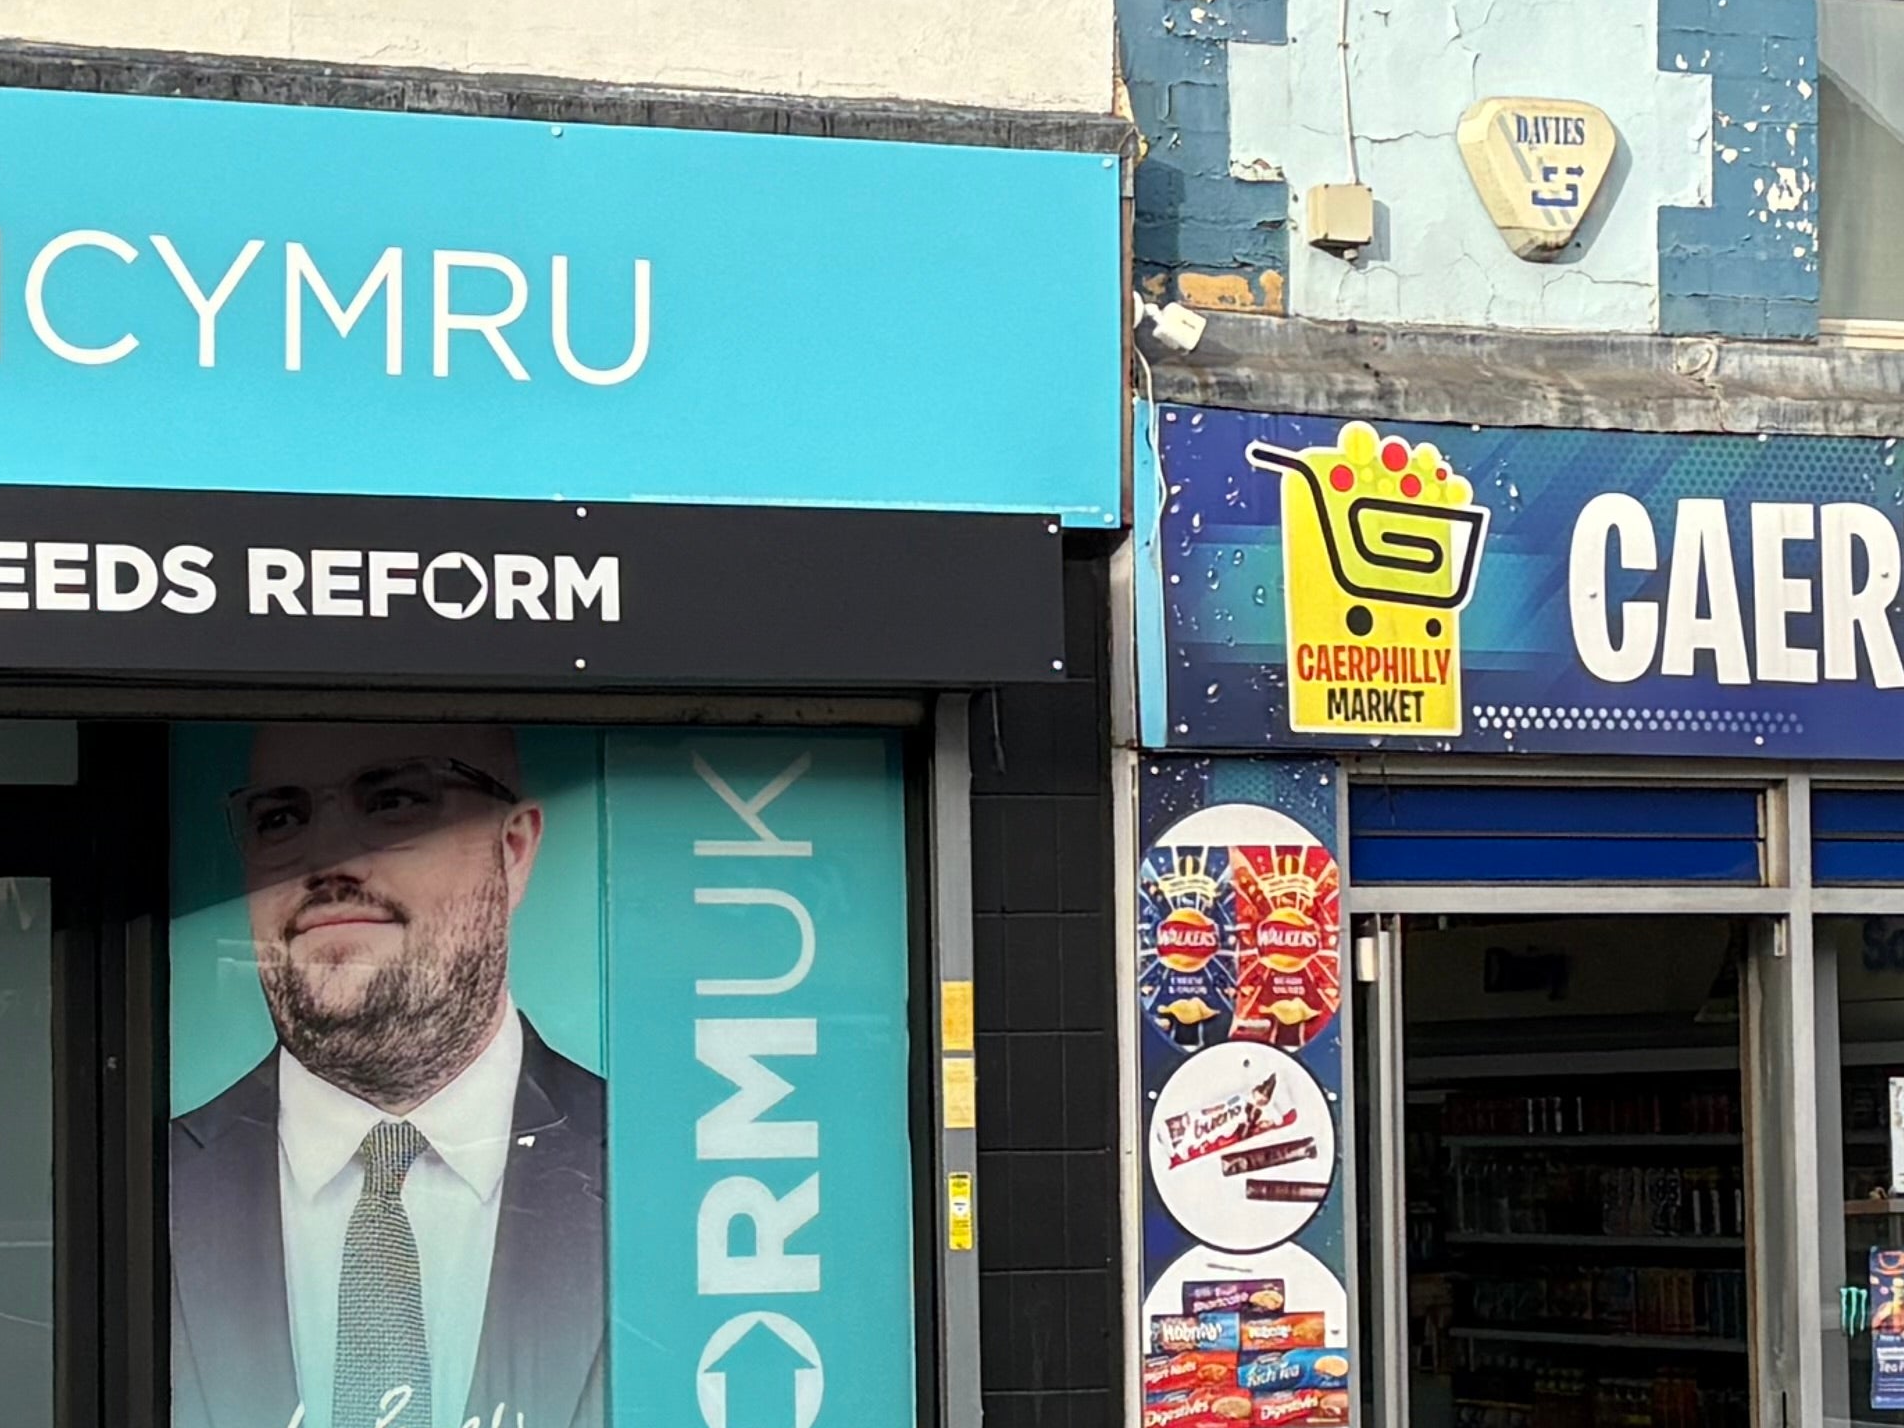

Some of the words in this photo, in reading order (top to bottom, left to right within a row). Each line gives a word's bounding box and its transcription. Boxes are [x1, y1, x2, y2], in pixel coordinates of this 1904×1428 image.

[1515, 114, 1585, 146] DAVIES
[247, 546, 621, 624] REFORM
[1296, 642, 1451, 687] CAERPHILLY
[1326, 689, 1426, 725] MARKET
[1158, 927, 1217, 947] WALKERS
[1258, 926, 1318, 947] WALKERS
